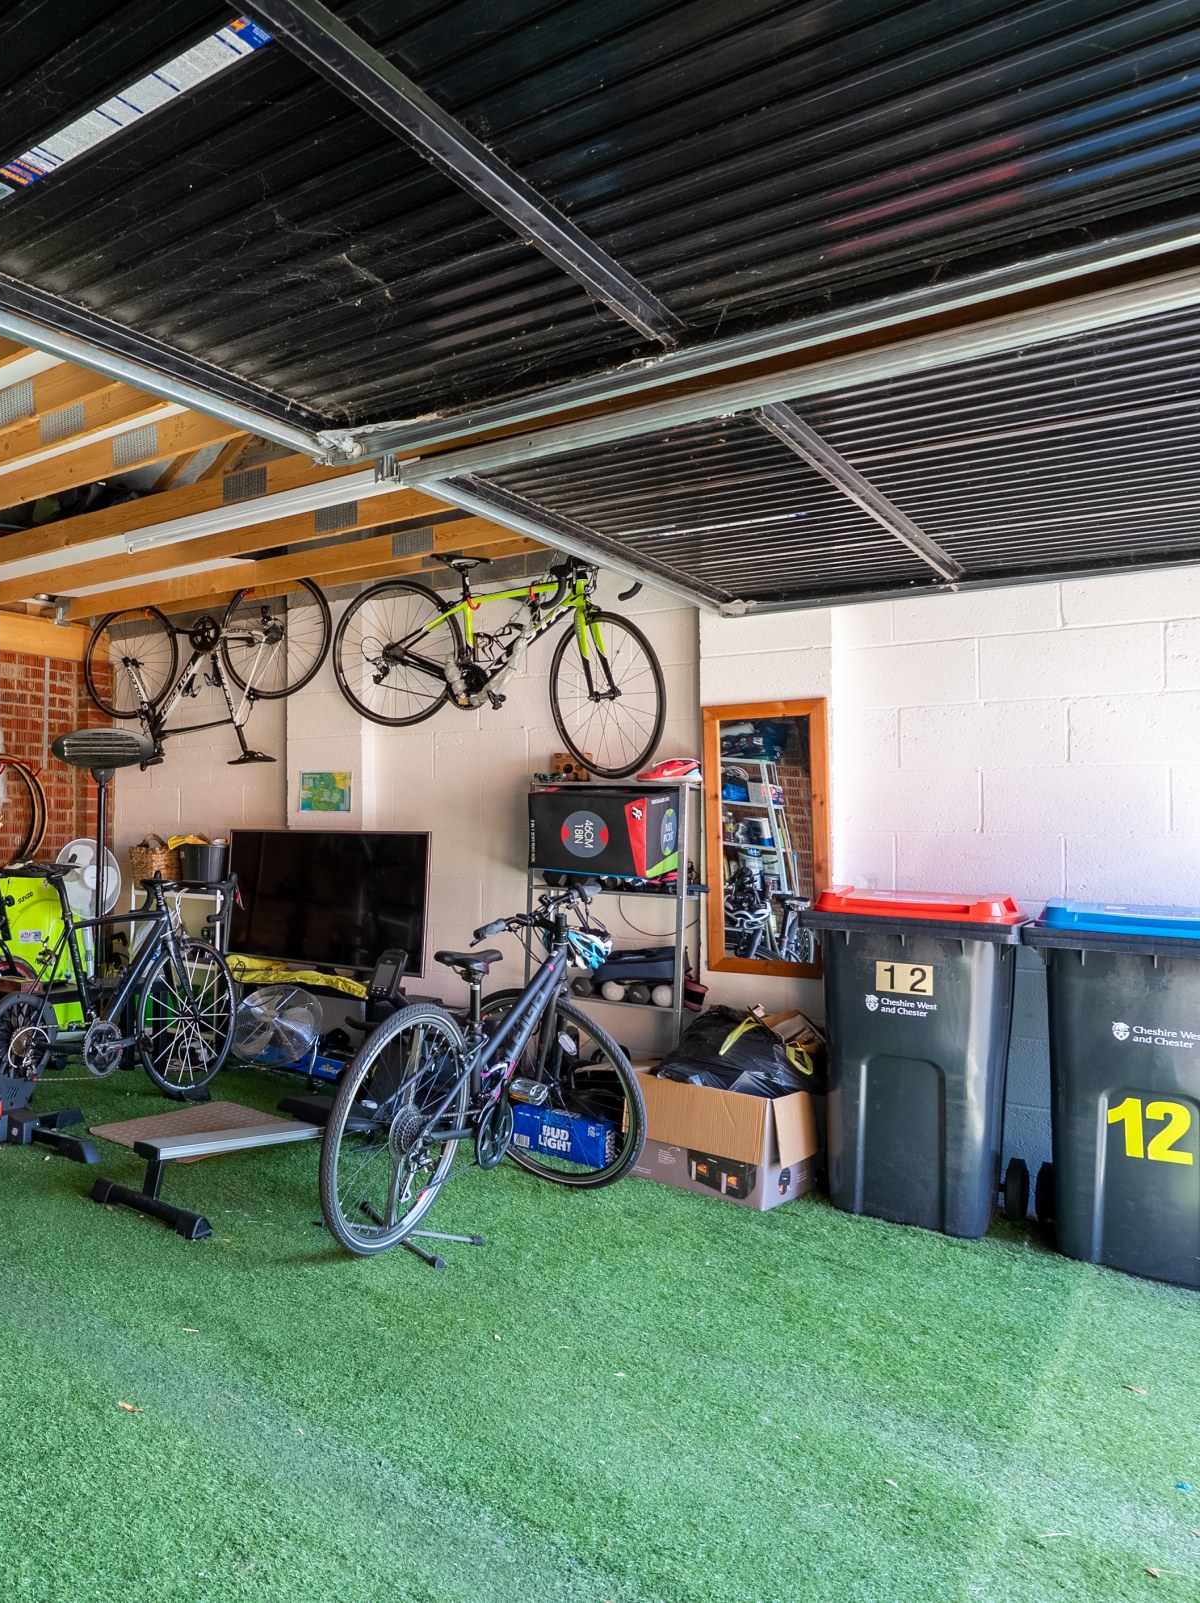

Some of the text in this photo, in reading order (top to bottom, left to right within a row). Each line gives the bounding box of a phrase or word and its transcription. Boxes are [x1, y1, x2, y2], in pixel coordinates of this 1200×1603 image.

[574, 824, 583, 844] 18IN
[584, 819, 594, 849] 46CM
[881, 997, 938, 1011] Cheshire West
[881, 1006, 928, 1017] and Chester
[1133, 1025, 1200, 1041] Cheshire Wes
[1133, 1035, 1194, 1049] and Chester
[542, 1125, 569, 1141] BUD
[1107, 1097, 1194, 1165] 12
[538, 1134, 572, 1152] LIGHT
